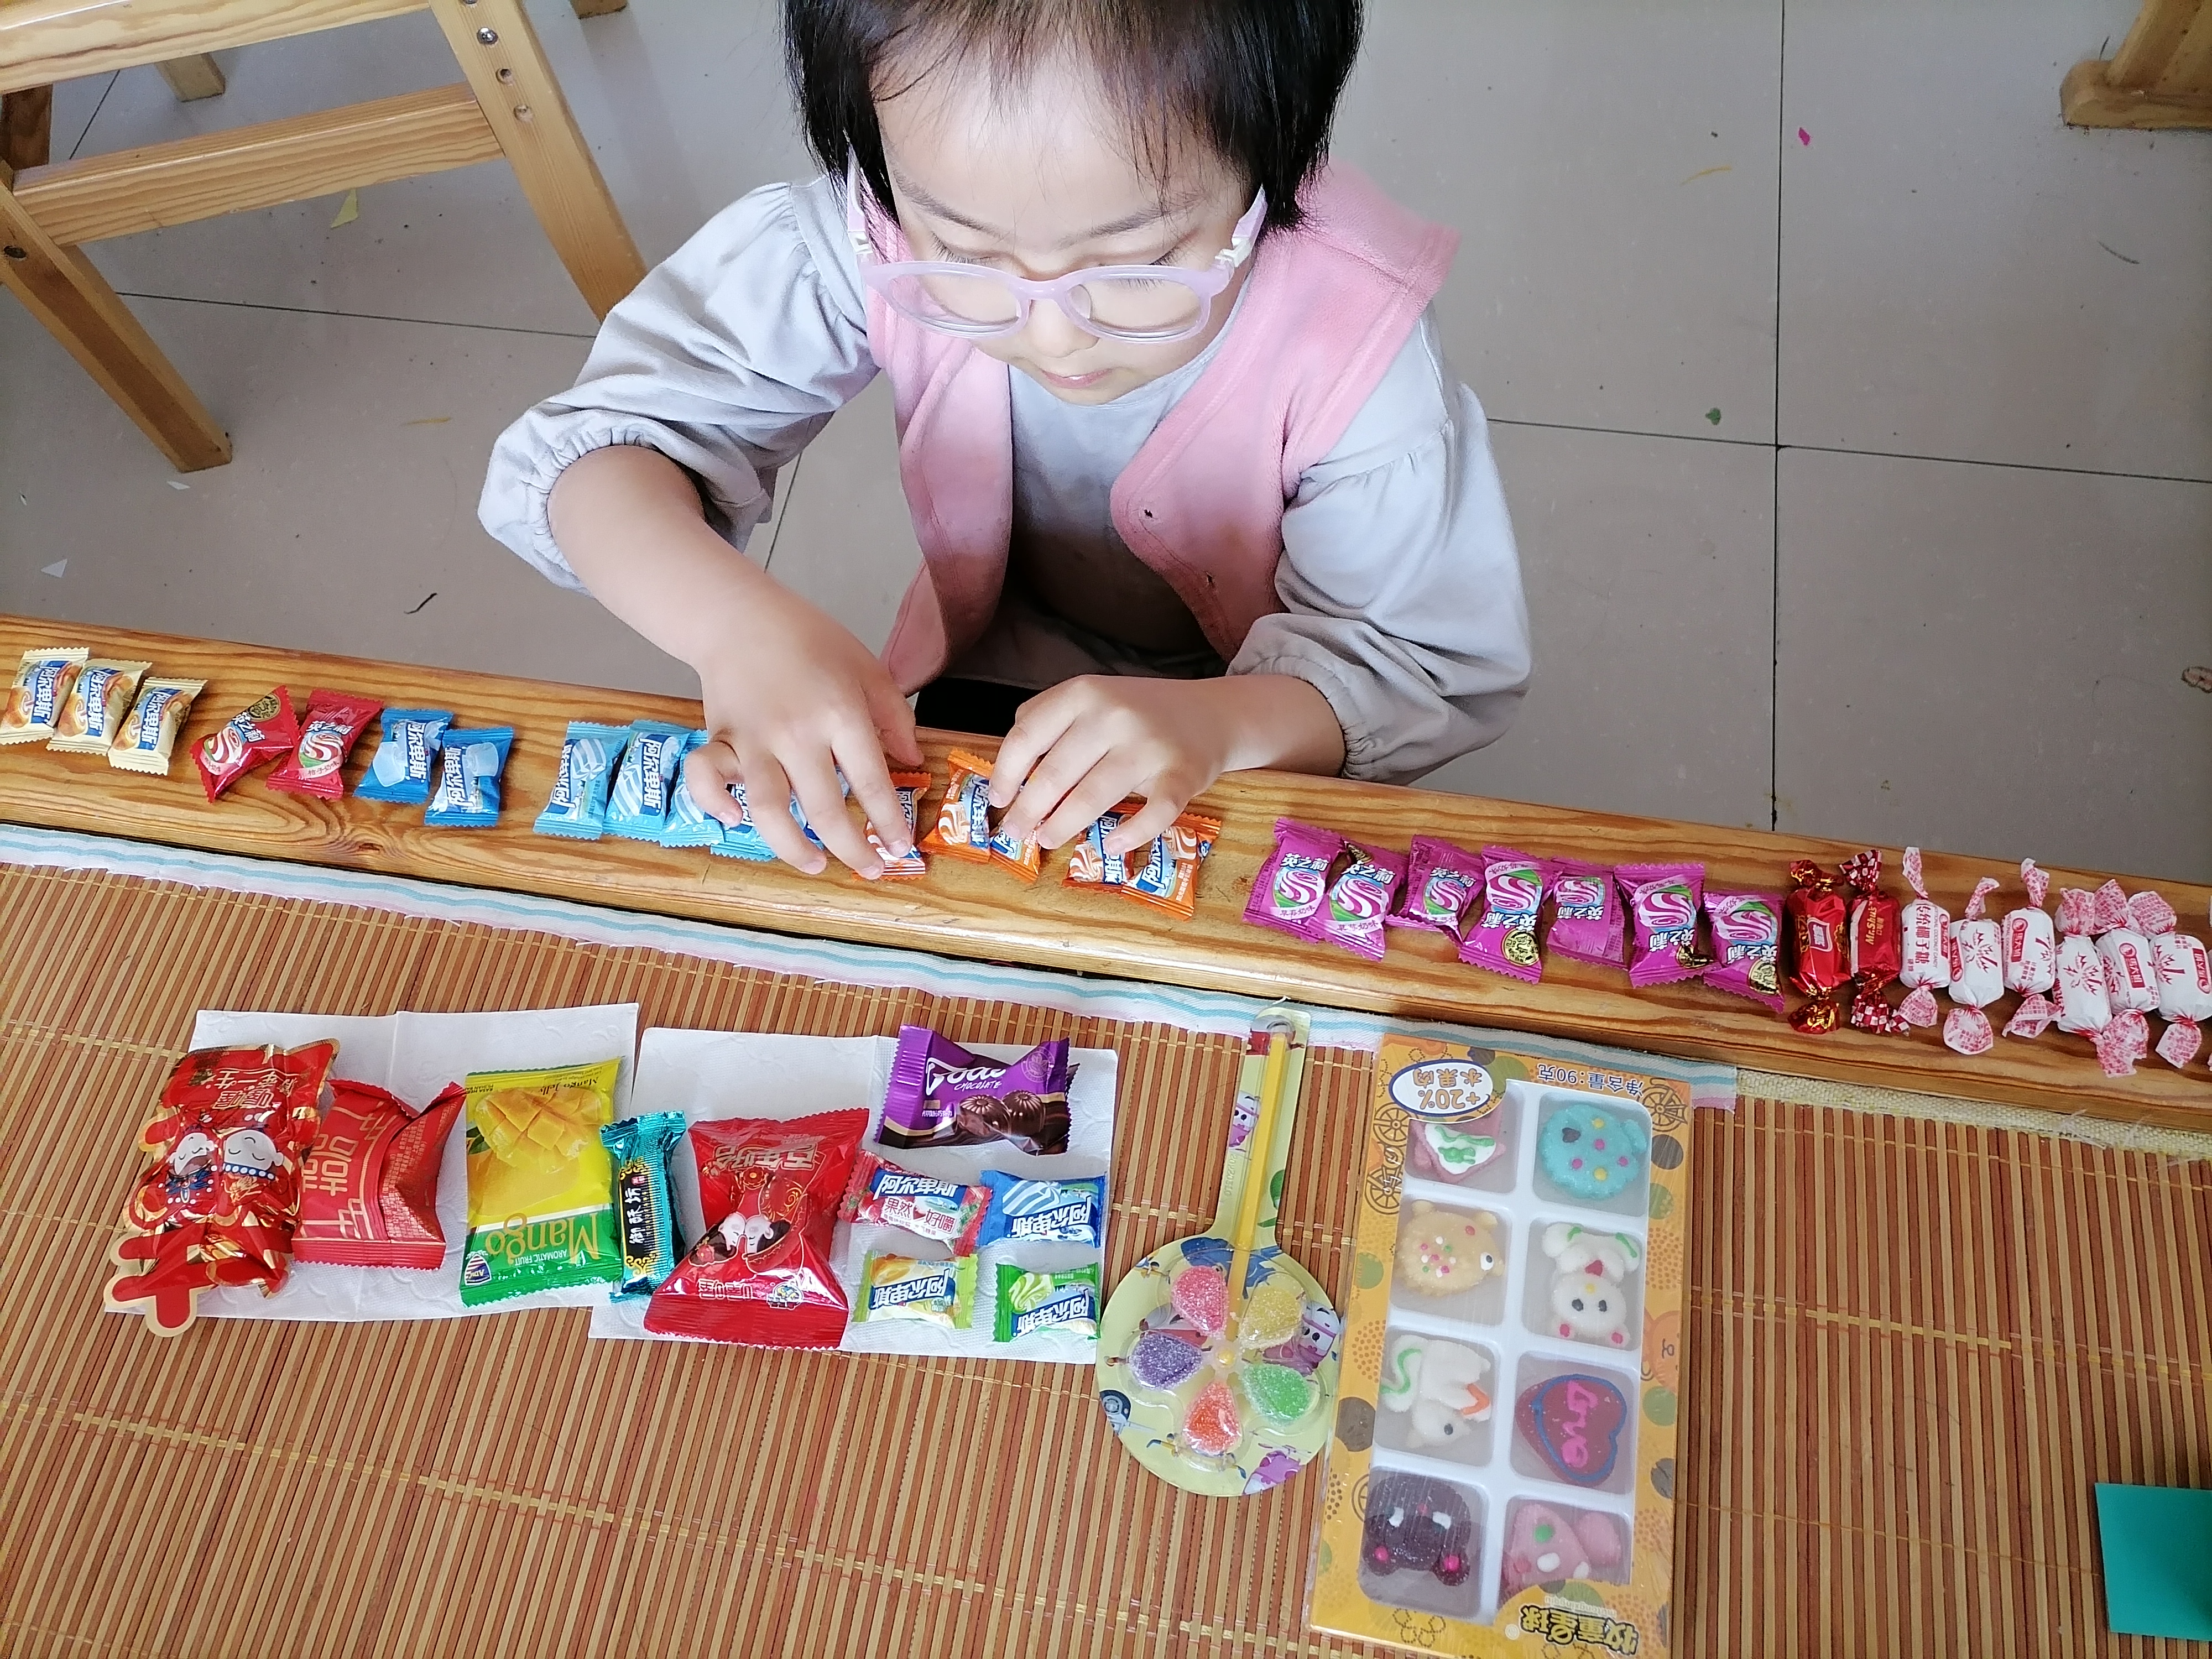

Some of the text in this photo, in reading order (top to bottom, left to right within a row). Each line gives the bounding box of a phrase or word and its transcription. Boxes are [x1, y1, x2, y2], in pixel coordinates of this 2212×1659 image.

[34, 665, 61, 720] 阿尔卑斯
[87, 670, 112, 731] 阿尔卑斯
[141, 691, 173, 744] 阿尔卑斯
[306, 721, 355, 734] 英之莉
[406, 721, 427, 781] 阿尔卑斯
[444, 747, 474, 806] 阿尔卑斯
[639, 738, 663, 808] 阿尔卑斯
[1280, 853, 1329, 872] 英之莉
[1342, 861, 1396, 885] 英之莉
[1430, 867, 1477, 888] 英之莉
[1481, 911, 1539, 931] 英之莉
[1557, 906, 1604, 920] 英之莉
[1649, 929, 1695, 952] 英之莉
[1726, 945, 1778, 964] 英之莉
[537, 1076, 599, 1096] Mango Jelly
[953, 1079, 1003, 1091] CHOCOLATE
[1412, 1067, 1483, 1087] 水果肉
[1418, 1088, 1481, 1110] +20%
[714, 1144, 817, 1171] 百年好合
[873, 1173, 959, 1201] 阿尔卑斯
[884, 1197, 957, 1233] 果然 好嚼
[1010, 1196, 1091, 1238] 阿尔卑斯
[485, 1212, 603, 1265] Mango
[514, 1248, 568, 1266] AROMATIC FRUIT
[873, 1269, 950, 1308] 阿尔卑斯
[1016, 1289, 1089, 1336] 阿尔卑斯
[1520, 1604, 1639, 1655] 牧童星球
